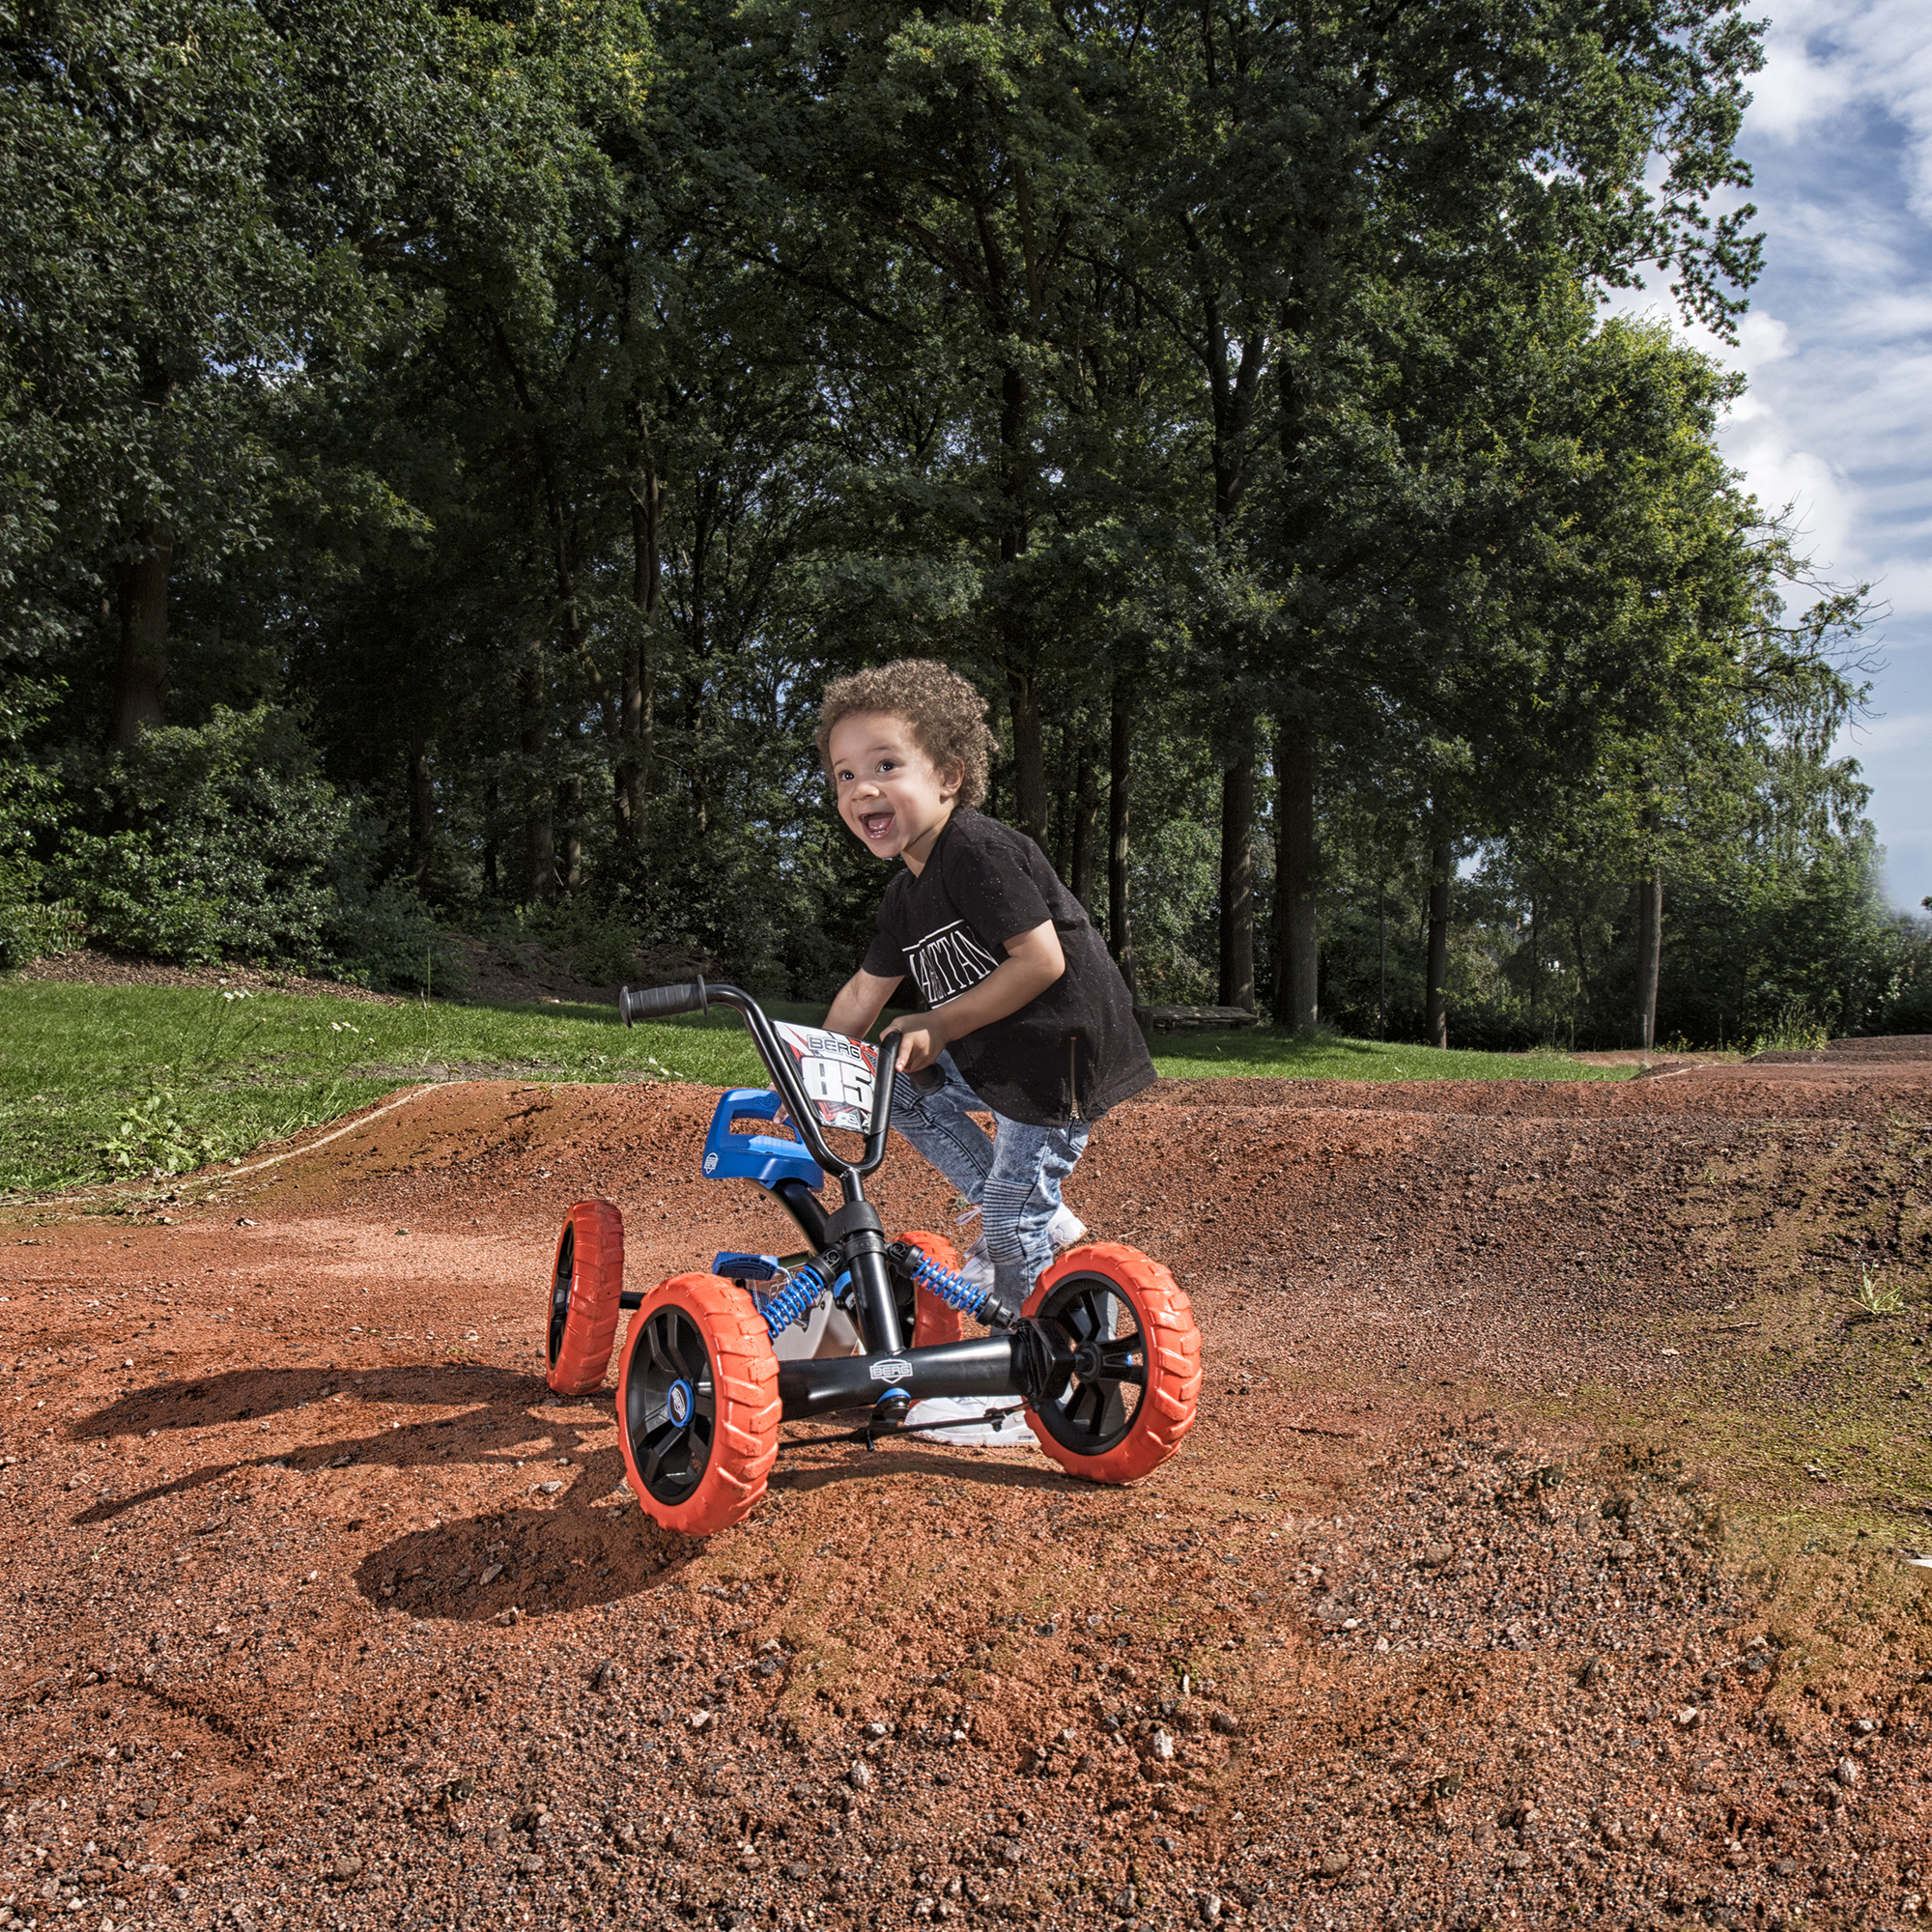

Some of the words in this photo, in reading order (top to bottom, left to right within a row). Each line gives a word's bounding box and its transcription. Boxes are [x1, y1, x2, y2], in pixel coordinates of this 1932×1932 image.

[810, 1037, 861, 1059] BERG
[801, 1056, 874, 1113] 85
[872, 1364, 911, 1377] BERG
